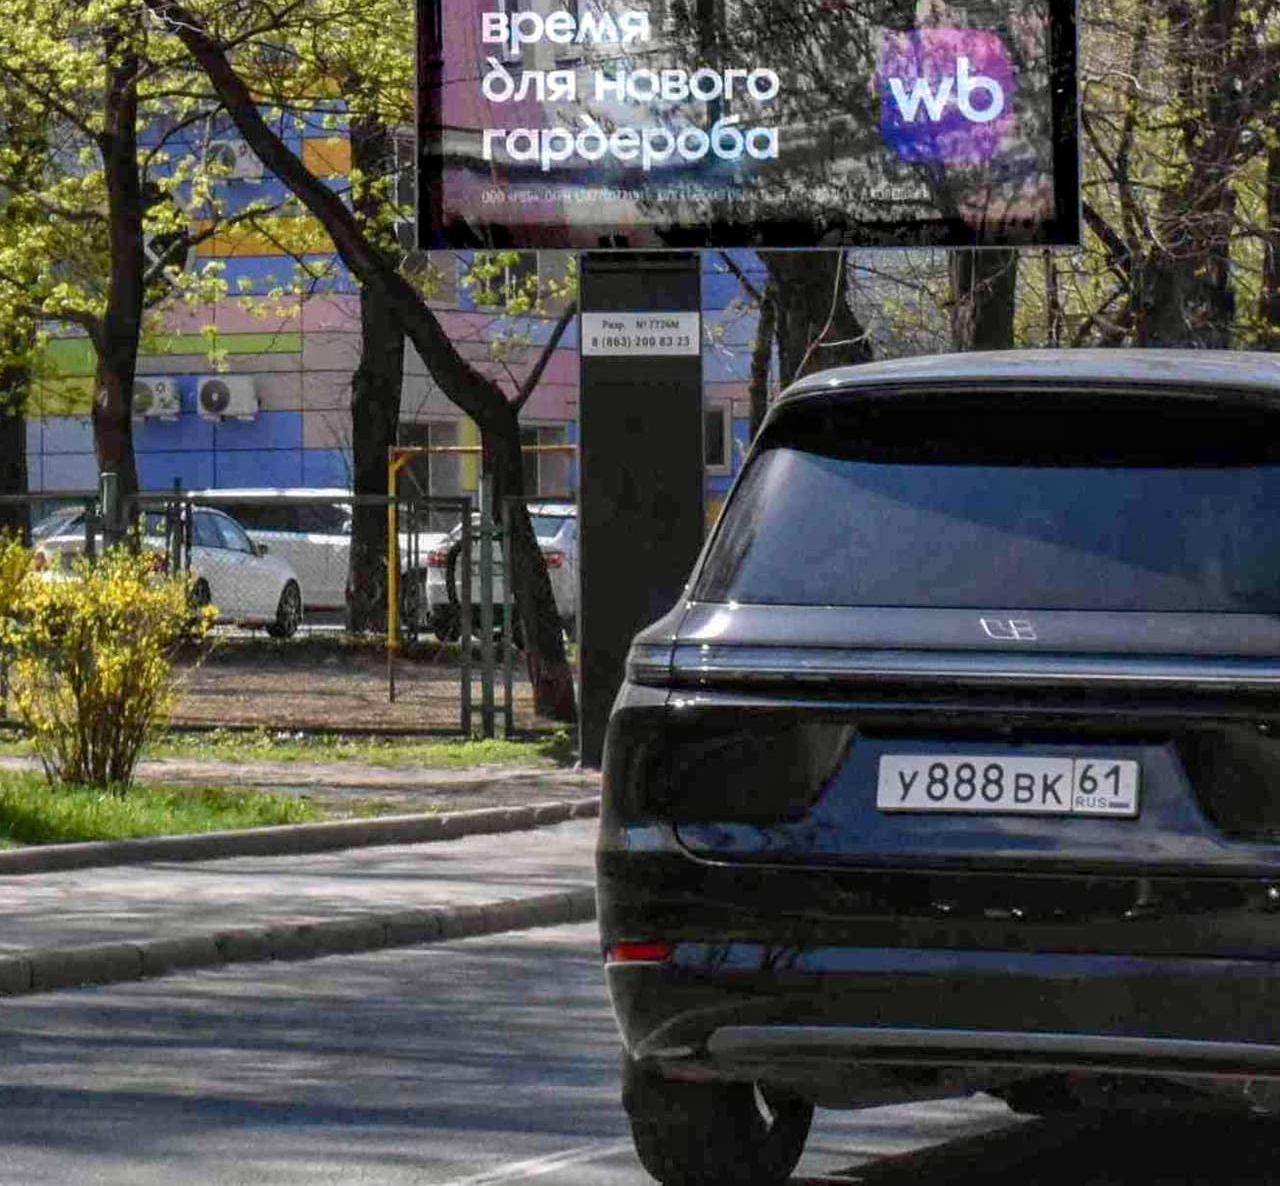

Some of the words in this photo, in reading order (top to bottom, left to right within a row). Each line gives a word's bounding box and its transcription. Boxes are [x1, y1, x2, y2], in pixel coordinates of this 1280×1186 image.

[481, 11, 650, 55] время
[481, 57, 577, 102] для
[594, 68, 780, 102] нового
[888, 56, 1005, 123] wb
[481, 114, 780, 172] гардероба
[591, 337, 599, 348] 8
[602, 336, 632, 348] (863)
[635, 336, 656, 348] 200
[659, 336, 673, 348] 83
[1078, 764, 1121, 796] 61
[1075, 797, 1107, 809] RUS
